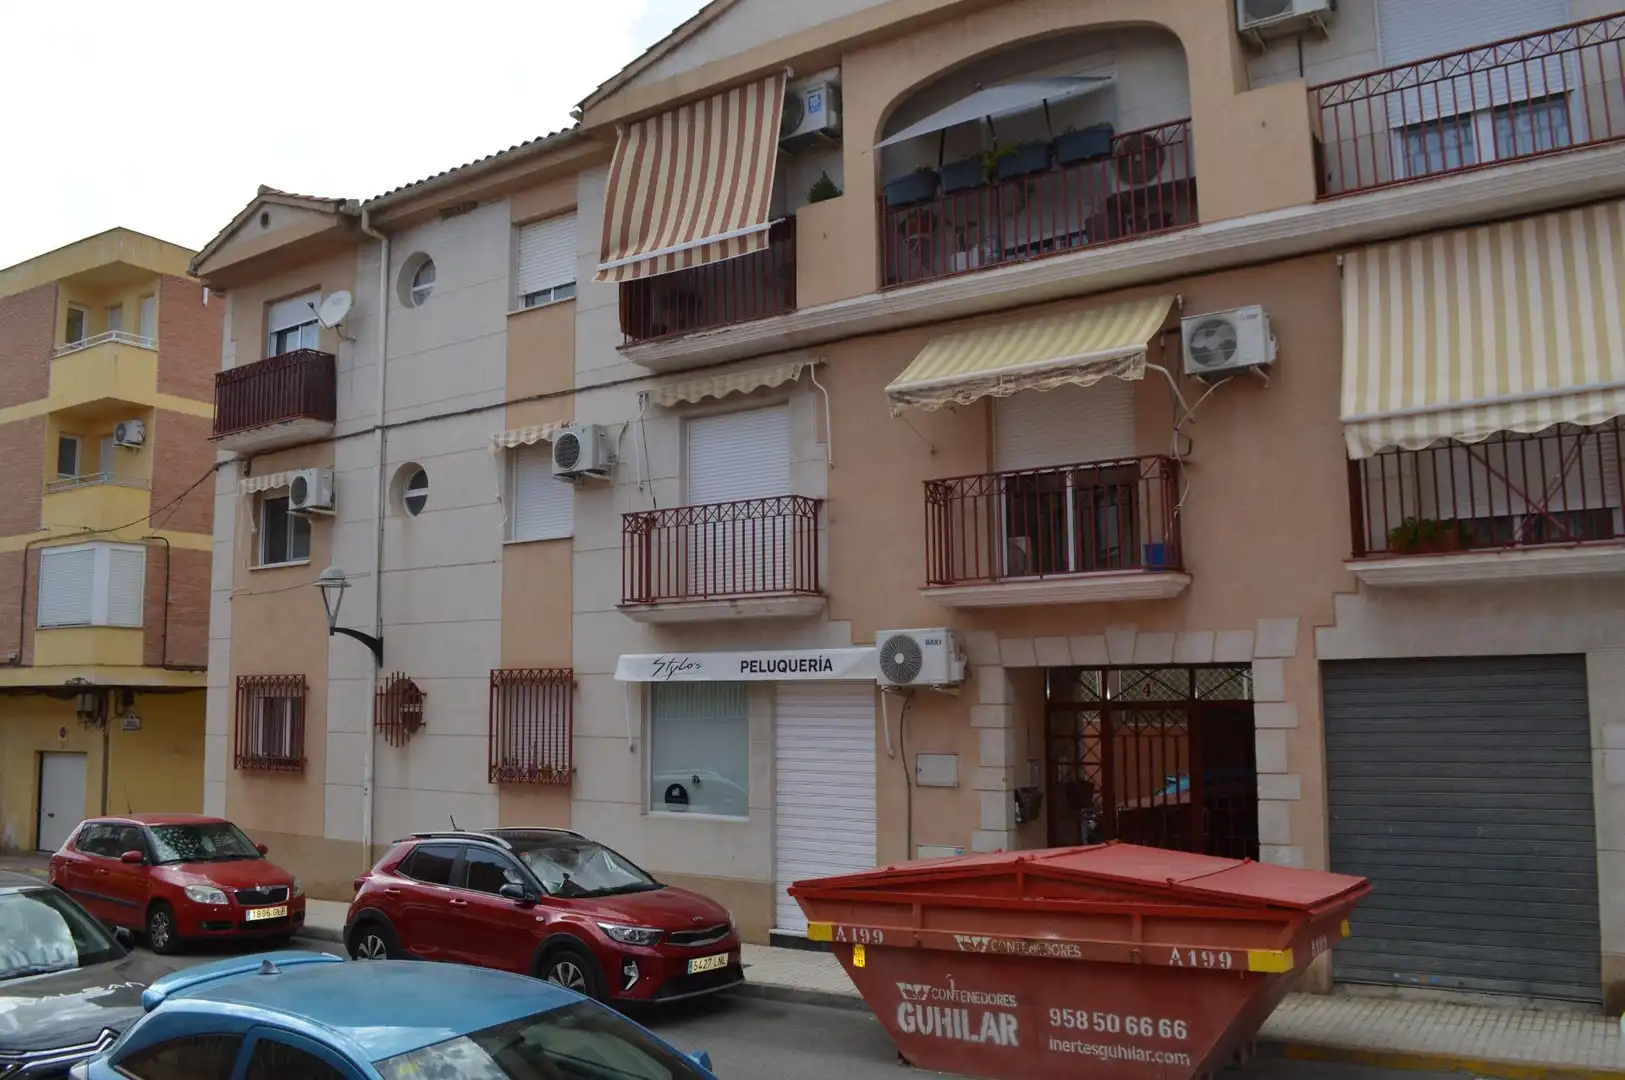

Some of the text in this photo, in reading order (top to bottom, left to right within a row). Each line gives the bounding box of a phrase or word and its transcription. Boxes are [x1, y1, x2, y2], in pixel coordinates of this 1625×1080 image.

[740, 655, 833, 674] PELUQUERÍA
[694, 958, 713, 971] 5427
[931, 987, 1018, 1008] CONTENEDORES
[897, 1001, 1020, 1047] GUHILAR
[1049, 1007, 1188, 1040] 958 50 66 66
[1049, 1035, 1191, 1066] inertesguhilar.com
